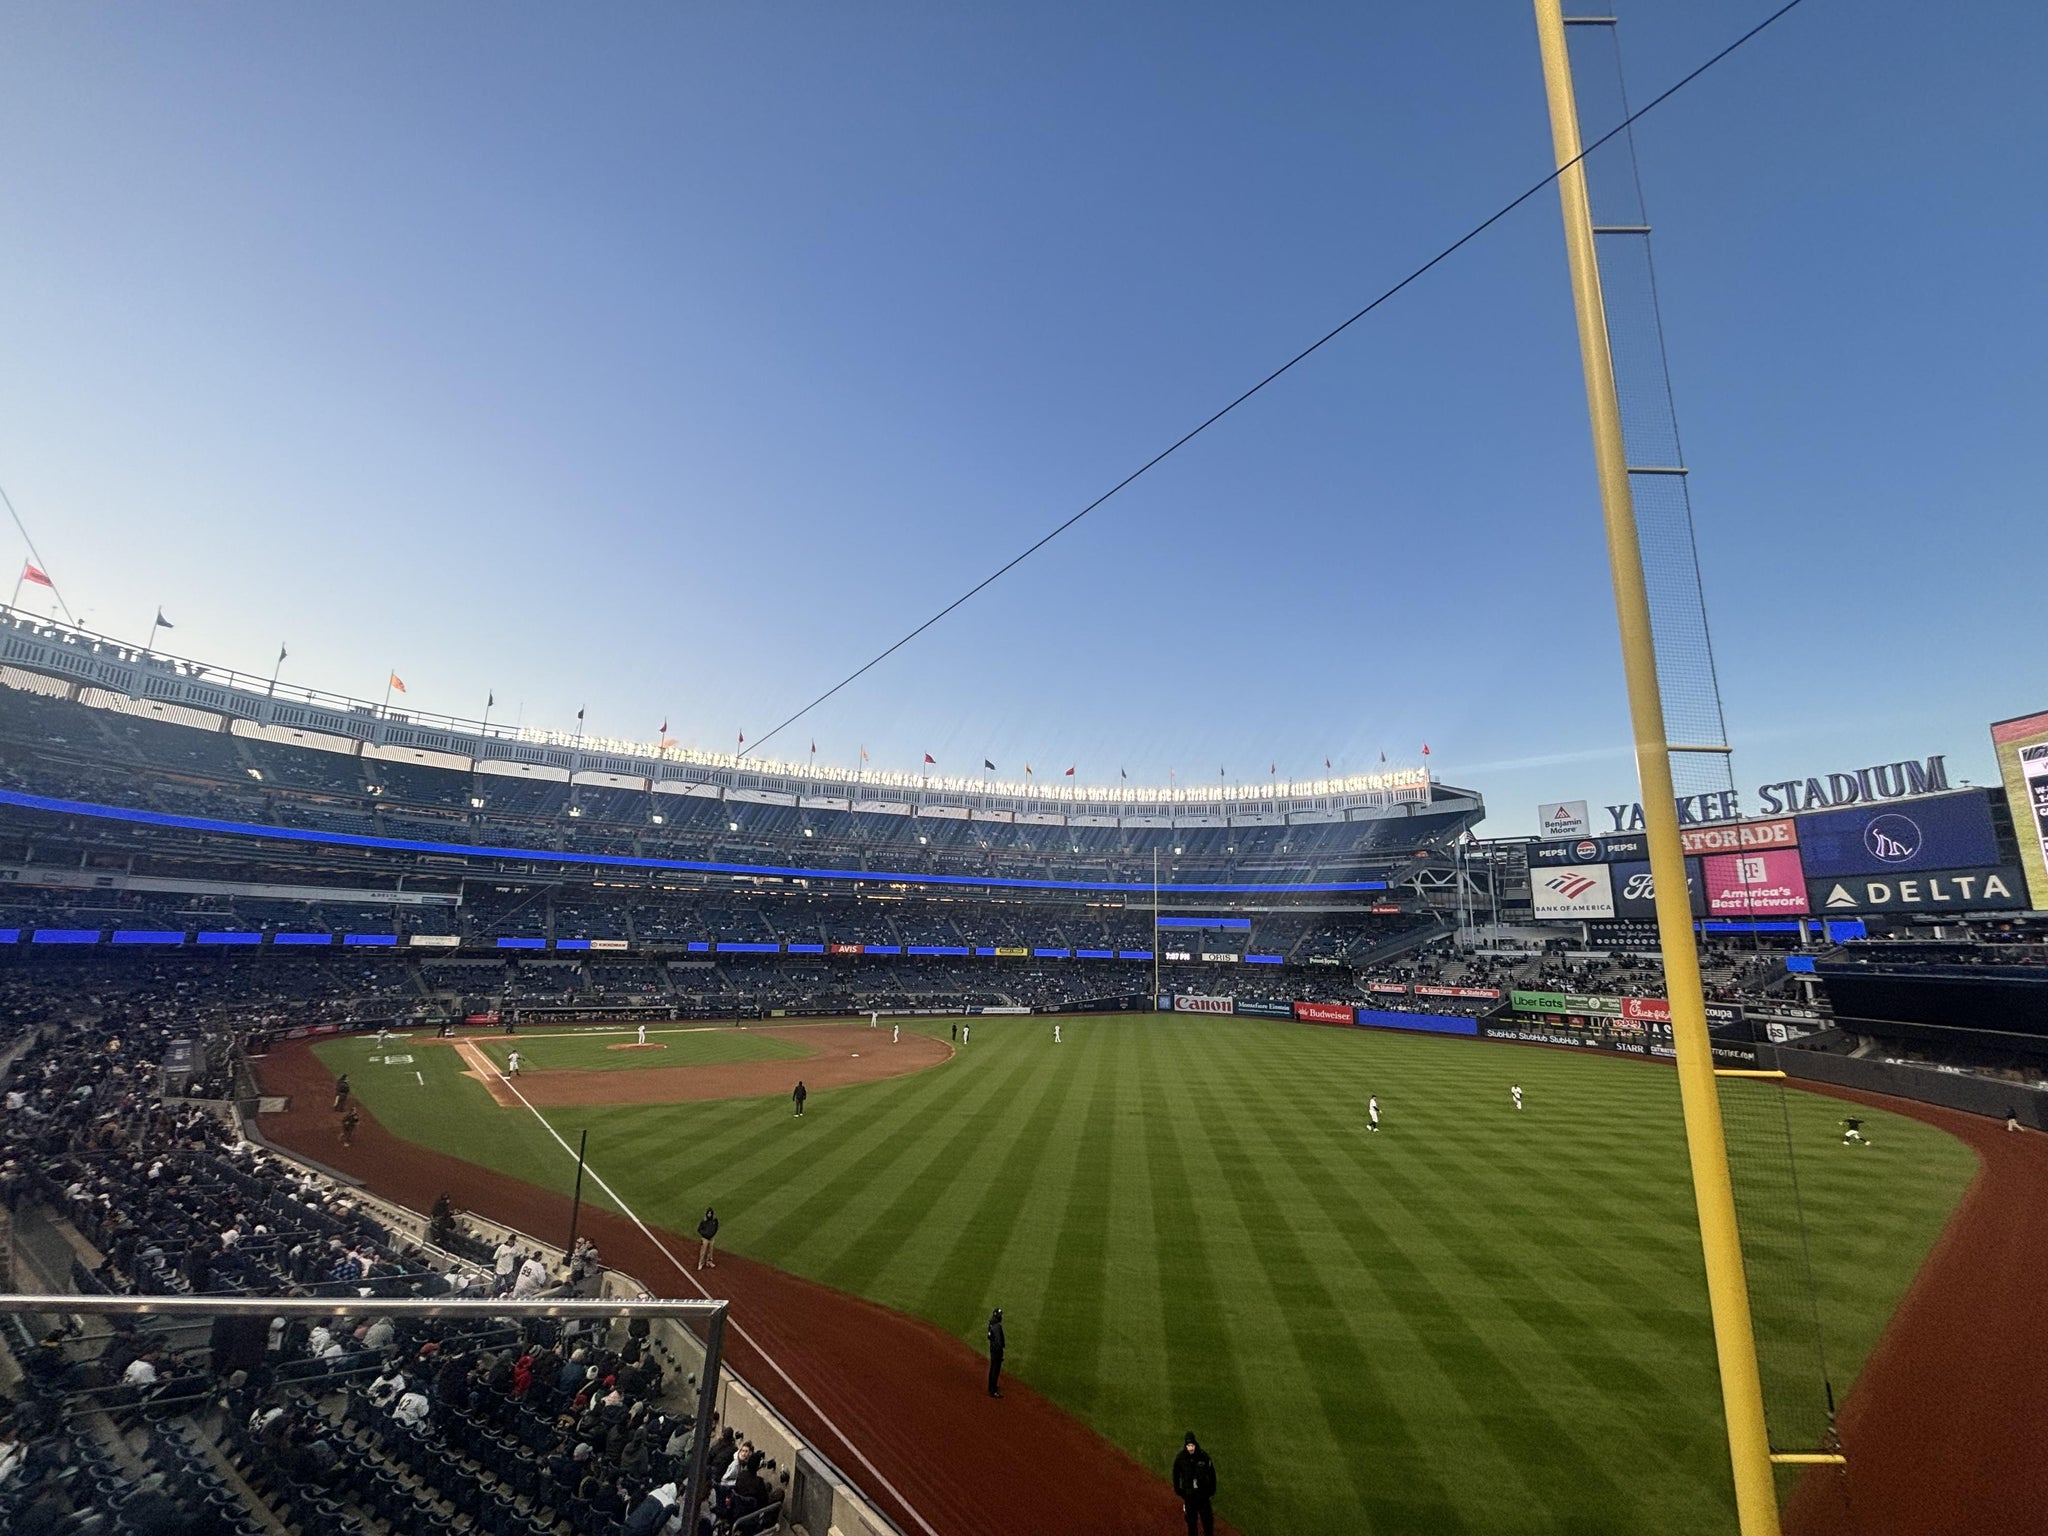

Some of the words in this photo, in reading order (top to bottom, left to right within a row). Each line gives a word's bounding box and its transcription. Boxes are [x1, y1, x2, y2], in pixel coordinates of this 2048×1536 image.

[1604, 789, 1743, 832] YAKEE
[1758, 755, 1949, 815] STADIUM
[1544, 818, 1582, 828] Benjamin
[1550, 827, 1576, 835] Moore
[1681, 824, 1788, 851] ATORADE
[1539, 848, 1567, 857] PEPSI
[1607, 843, 1637, 853] PEPSI
[1623, 873, 1693, 900] Fo
[1721, 887, 1791, 898] America's
[1866, 875, 2011, 905] DELTA
[1711, 899, 1742, 908] Best
[1743, 896, 1805, 908] Network
[1209, 953, 1231, 961] ORIS
[1175, 997, 1232, 1012] Canon
[1512, 996, 1538, 1007] Uber
[1538, 998, 1564, 1009] Eats
[1309, 1008, 1351, 1020] Budweiser
[1705, 1008, 1733, 1020] coupa
[1487, 1029, 1517, 1040] StubHub
[1518, 1032, 1548, 1043] StubHub
[1550, 1035, 1580, 1046] StubHub
[1616, 1042, 1644, 1054] STARR
